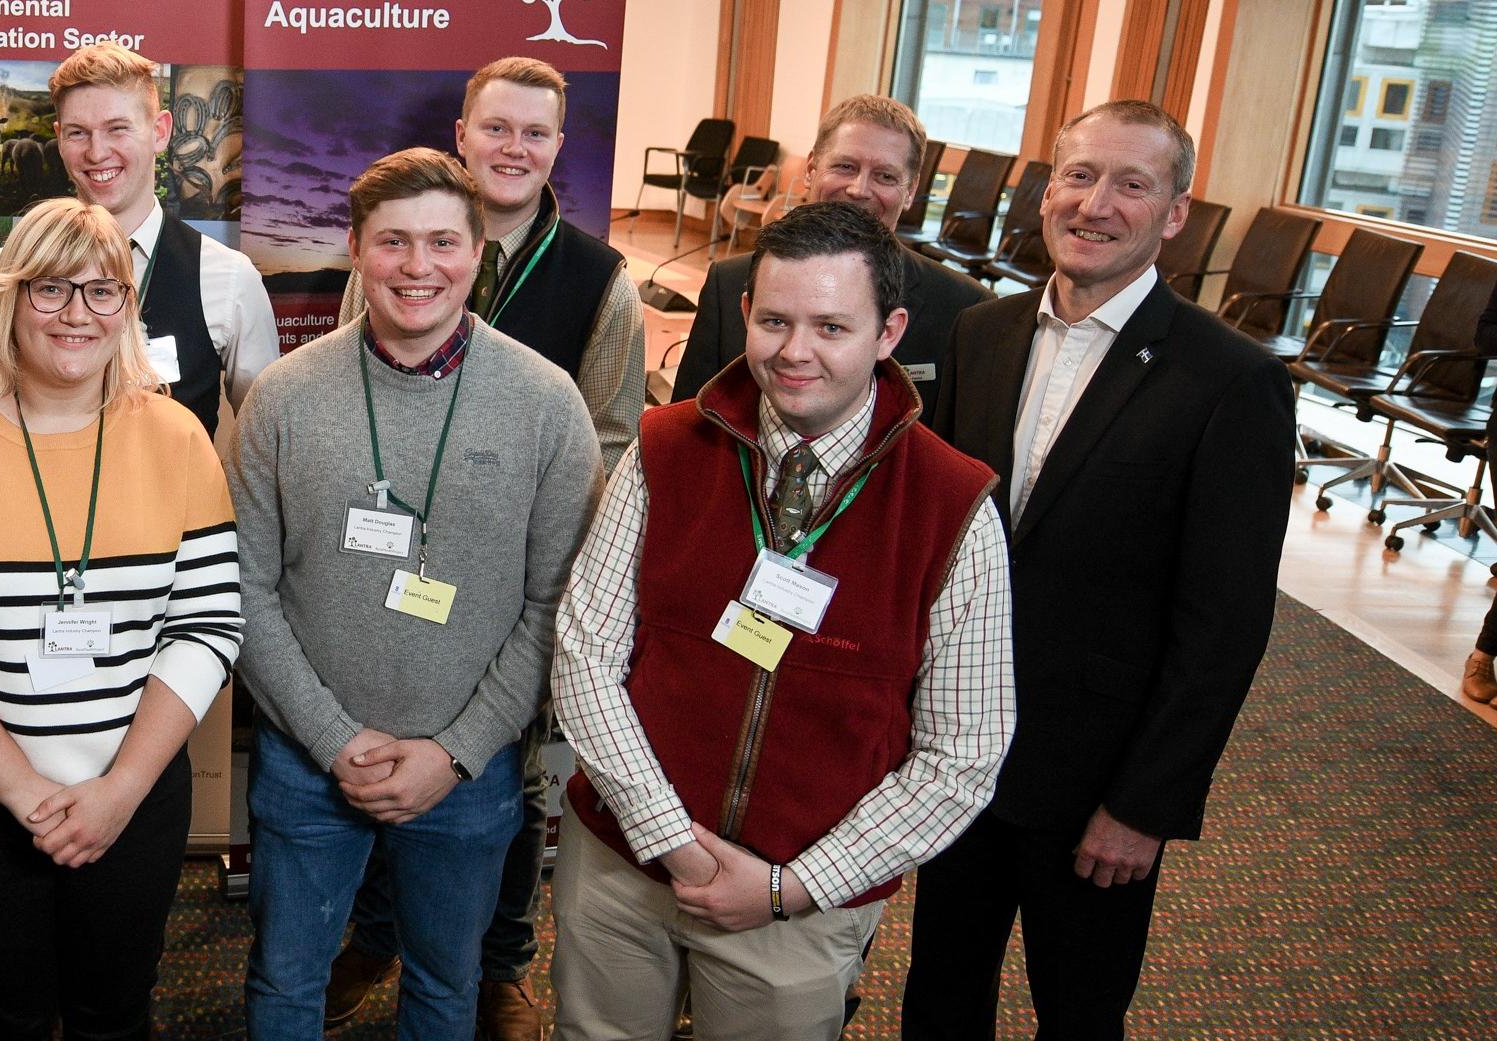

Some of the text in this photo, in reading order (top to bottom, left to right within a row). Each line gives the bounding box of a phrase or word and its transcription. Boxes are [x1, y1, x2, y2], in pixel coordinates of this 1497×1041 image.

[264, 1, 450, 34] Aquaculture
[276, 314, 335, 327] uaculture
[404, 588, 422, 599] Event
[422, 594, 441, 605] Guest
[736, 620, 754, 634] Event
[753, 630, 772, 645] Guest
